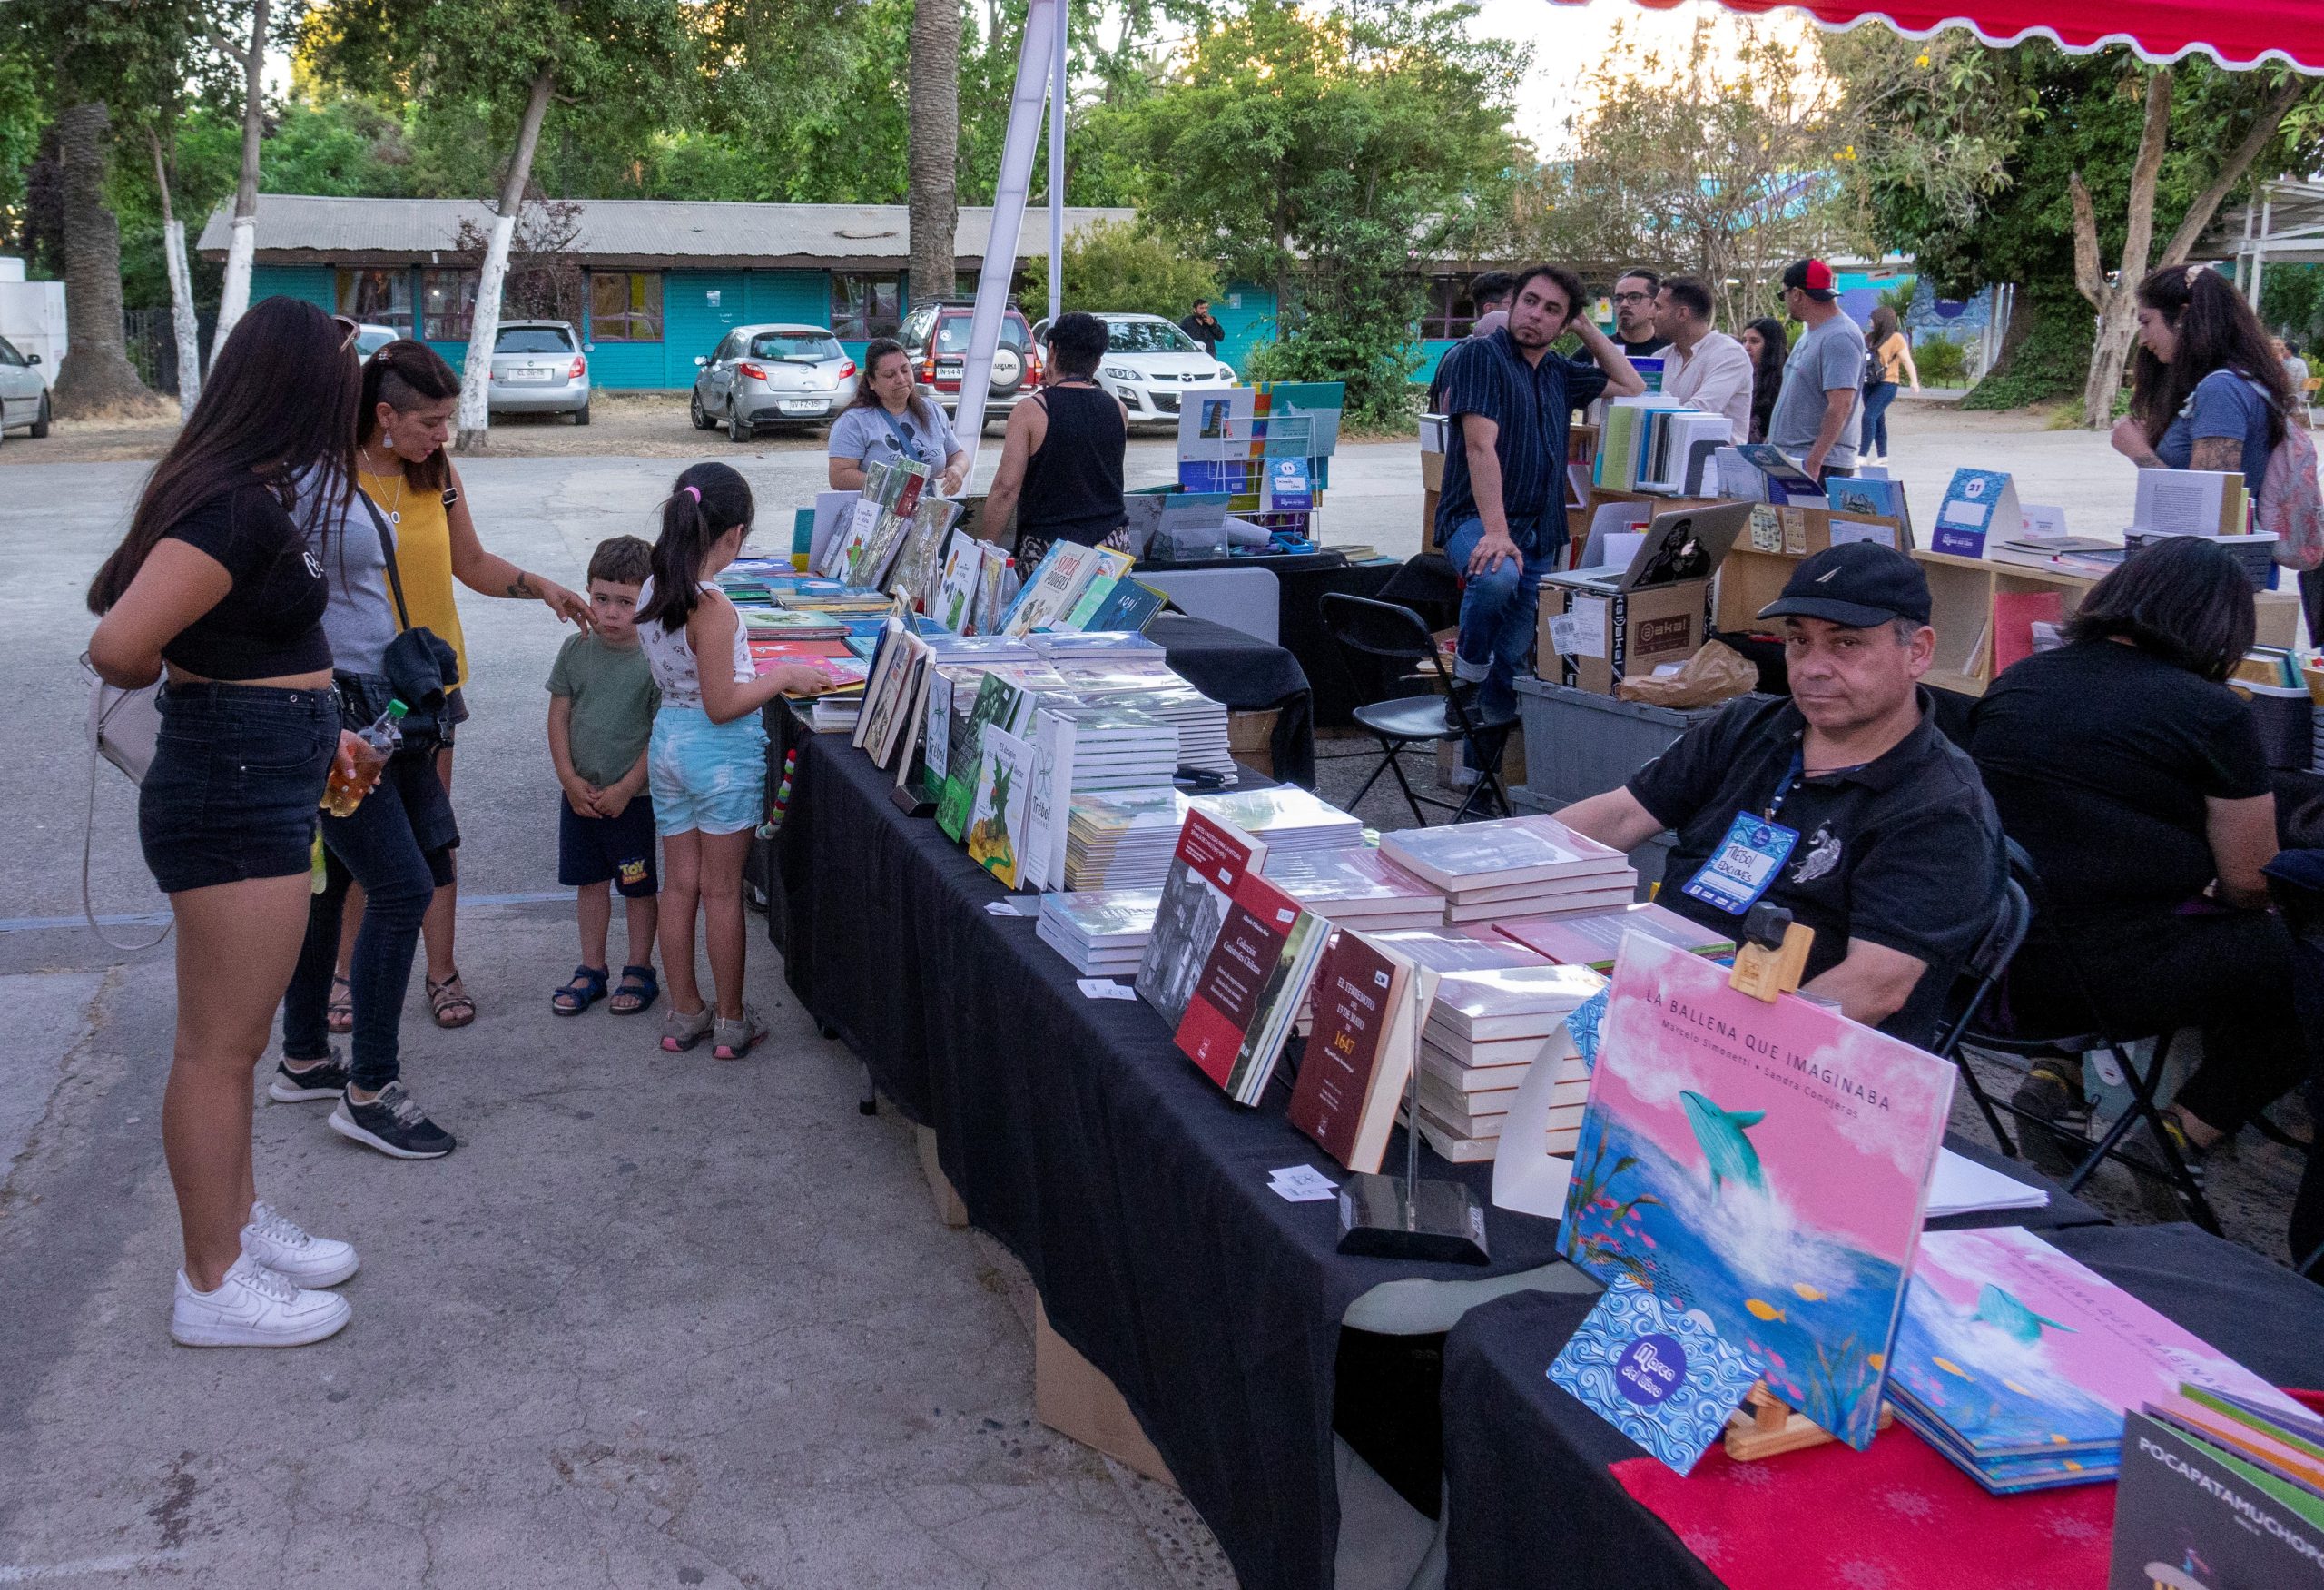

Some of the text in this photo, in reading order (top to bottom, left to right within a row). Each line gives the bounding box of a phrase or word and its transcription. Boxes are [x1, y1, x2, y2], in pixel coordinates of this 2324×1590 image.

[1968, 483, 1982, 491] 21
[1055, 555, 1080, 578] SUPER
[1045, 570, 1072, 591] PODERES
[928, 736, 946, 765] Trébol
[1033, 795, 1051, 822] Trébol
[1717, 860, 1753, 883] EDICIONES
[1337, 976, 1375, 1012] EL TERREMOTO
[1349, 1012, 1365, 1031] MAYO
[1334, 1030, 1355, 1055] 1647
[1646, 988, 1890, 1111] LA BALLENA QUE IMAGINABA
[1662, 1019, 1858, 1119] Marcelo Simonetti Sandra Conejeros
[2029, 1263, 2095, 1305] BALLENA
[2098, 1308, 2134, 1329] QUE
[2136, 1334, 2229, 1391] IMAGINAB
